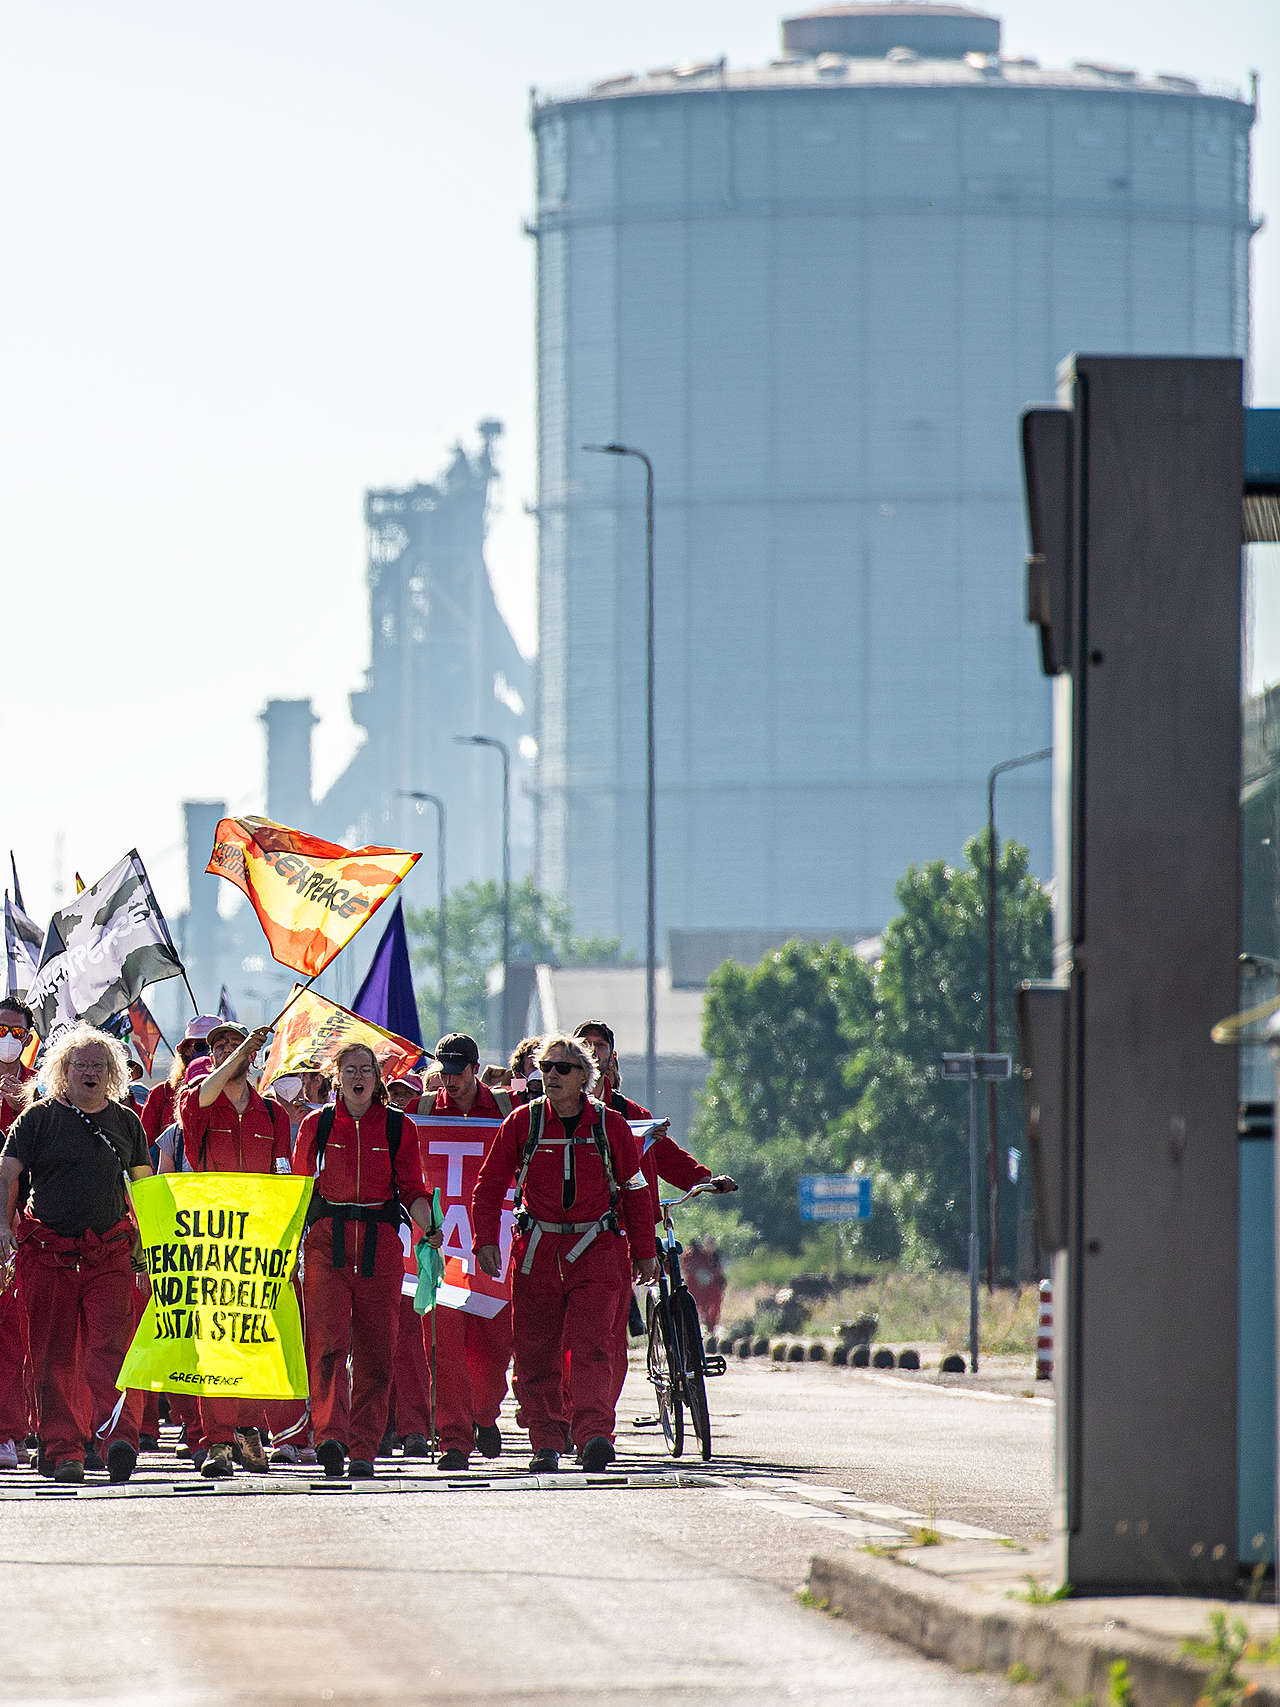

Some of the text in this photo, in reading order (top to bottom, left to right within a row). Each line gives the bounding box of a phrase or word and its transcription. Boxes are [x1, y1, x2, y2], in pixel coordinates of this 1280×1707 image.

[263, 851, 370, 919] ENPEACE
[174, 1210, 249, 1240] SLUIT
[144, 1243, 291, 1278] IEKMAKENDE
[211, 1311, 275, 1343] STEEL
[169, 1371, 243, 1386] GREENPEACE
